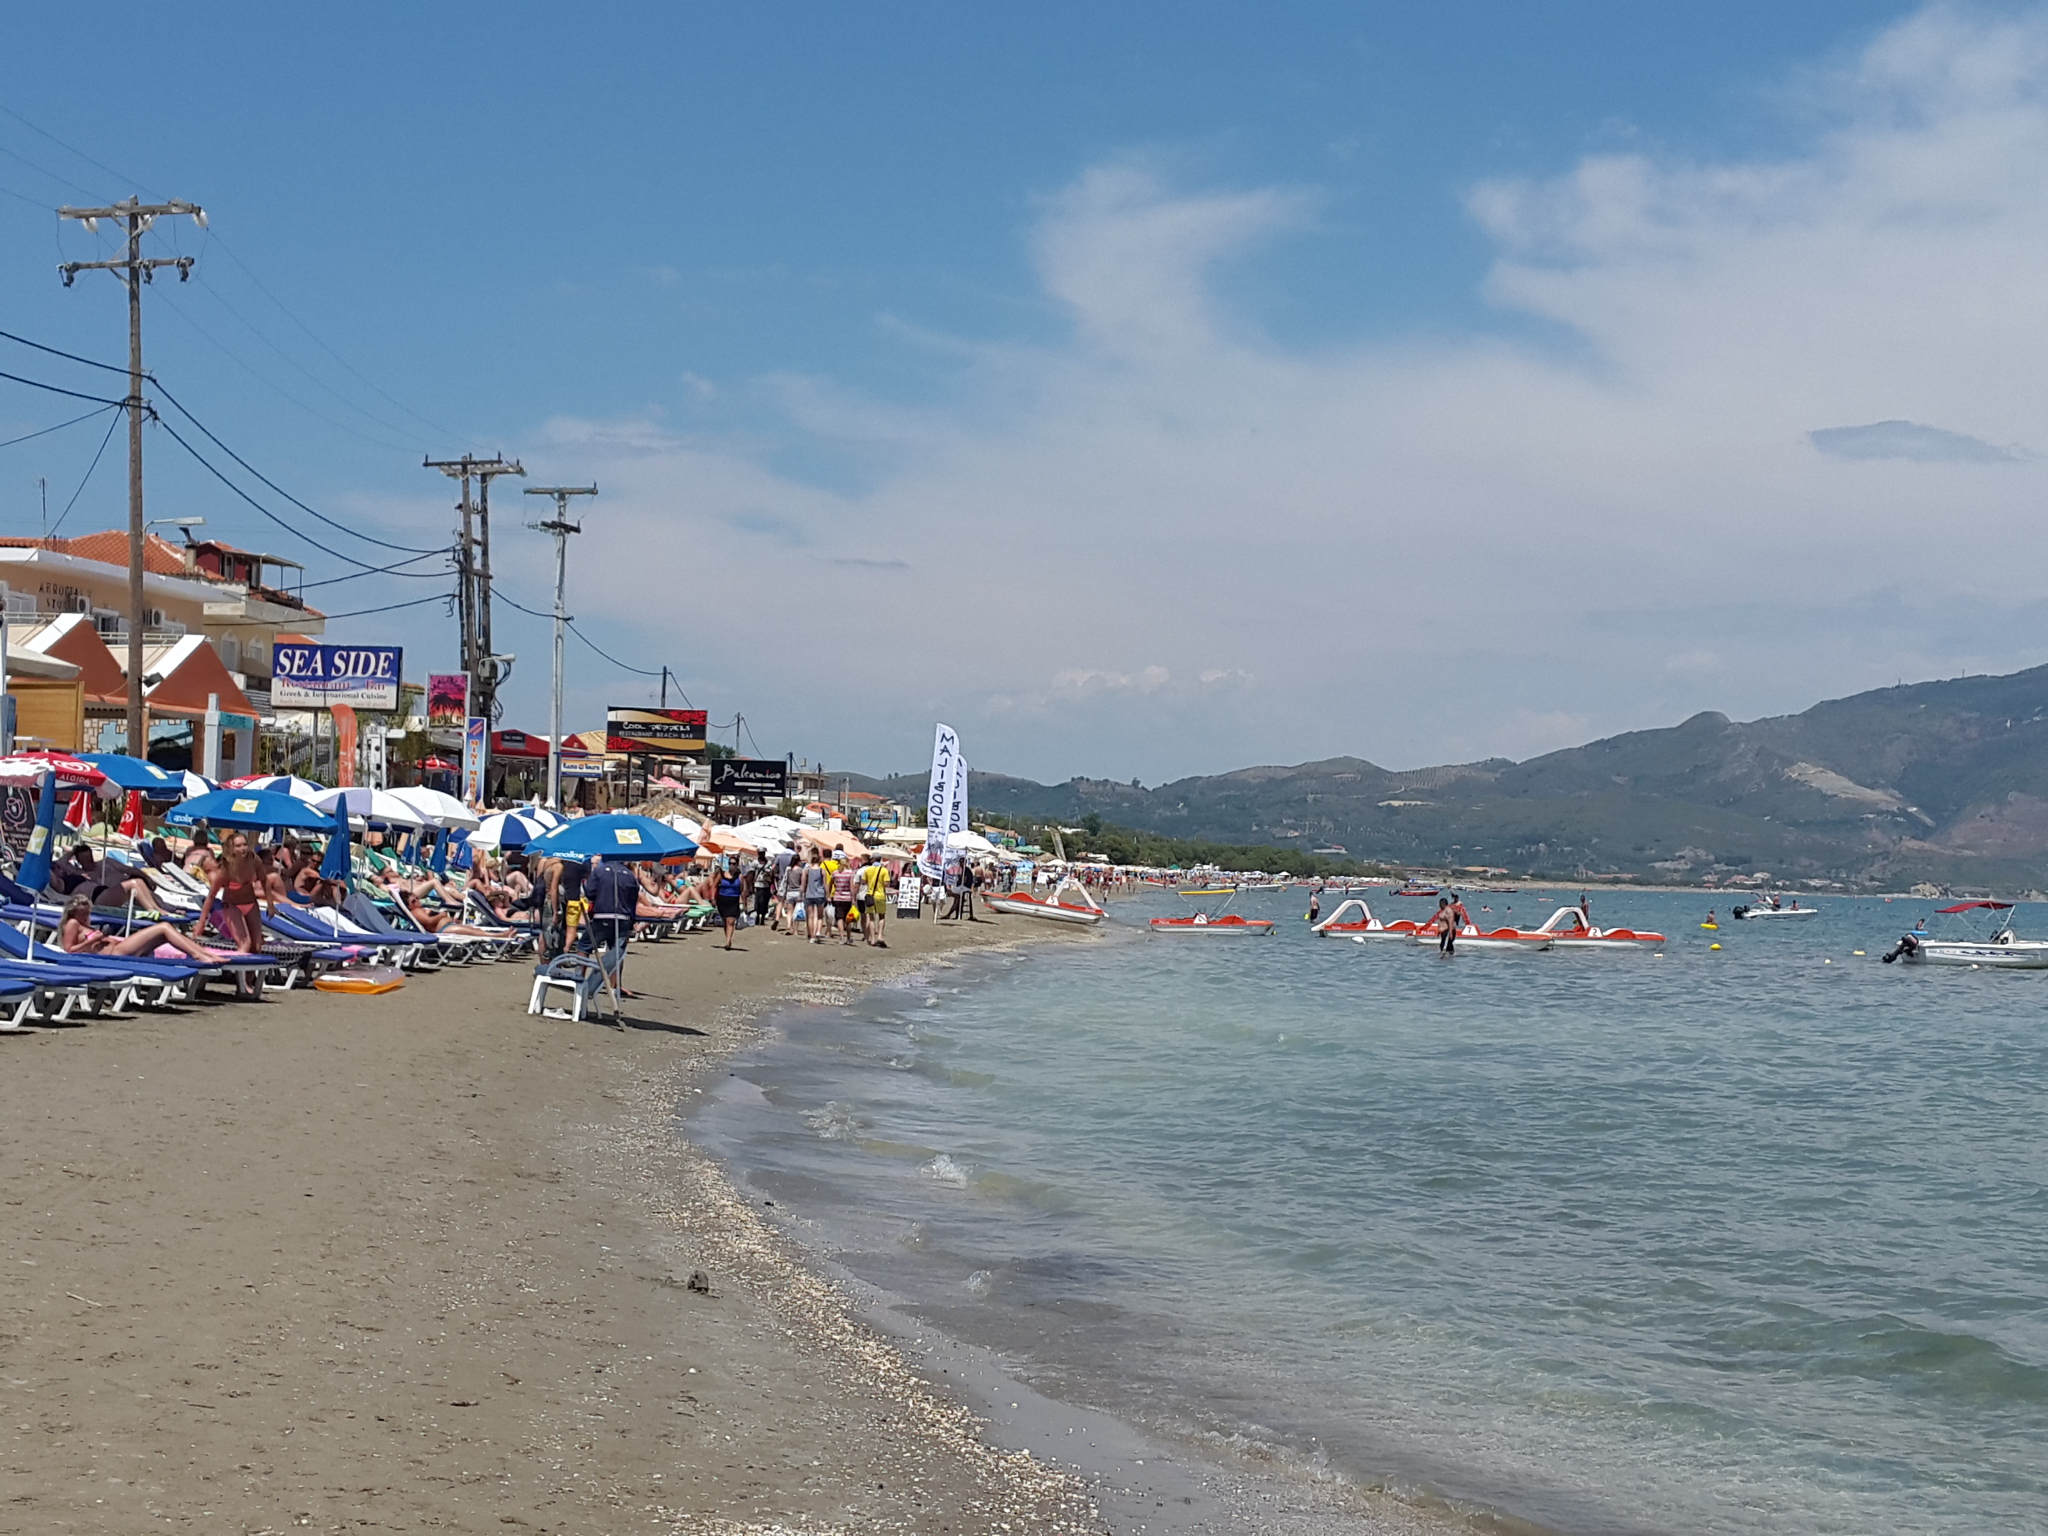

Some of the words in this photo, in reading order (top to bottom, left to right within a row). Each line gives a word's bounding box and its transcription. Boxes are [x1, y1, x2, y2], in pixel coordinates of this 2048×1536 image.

[276, 648, 325, 677] SEA
[331, 650, 394, 678] SIDE
[365, 679, 387, 691] Bar
[312, 691, 359, 699] International
[361, 691, 388, 699] Cuisine
[469, 740, 479, 766] MINI
